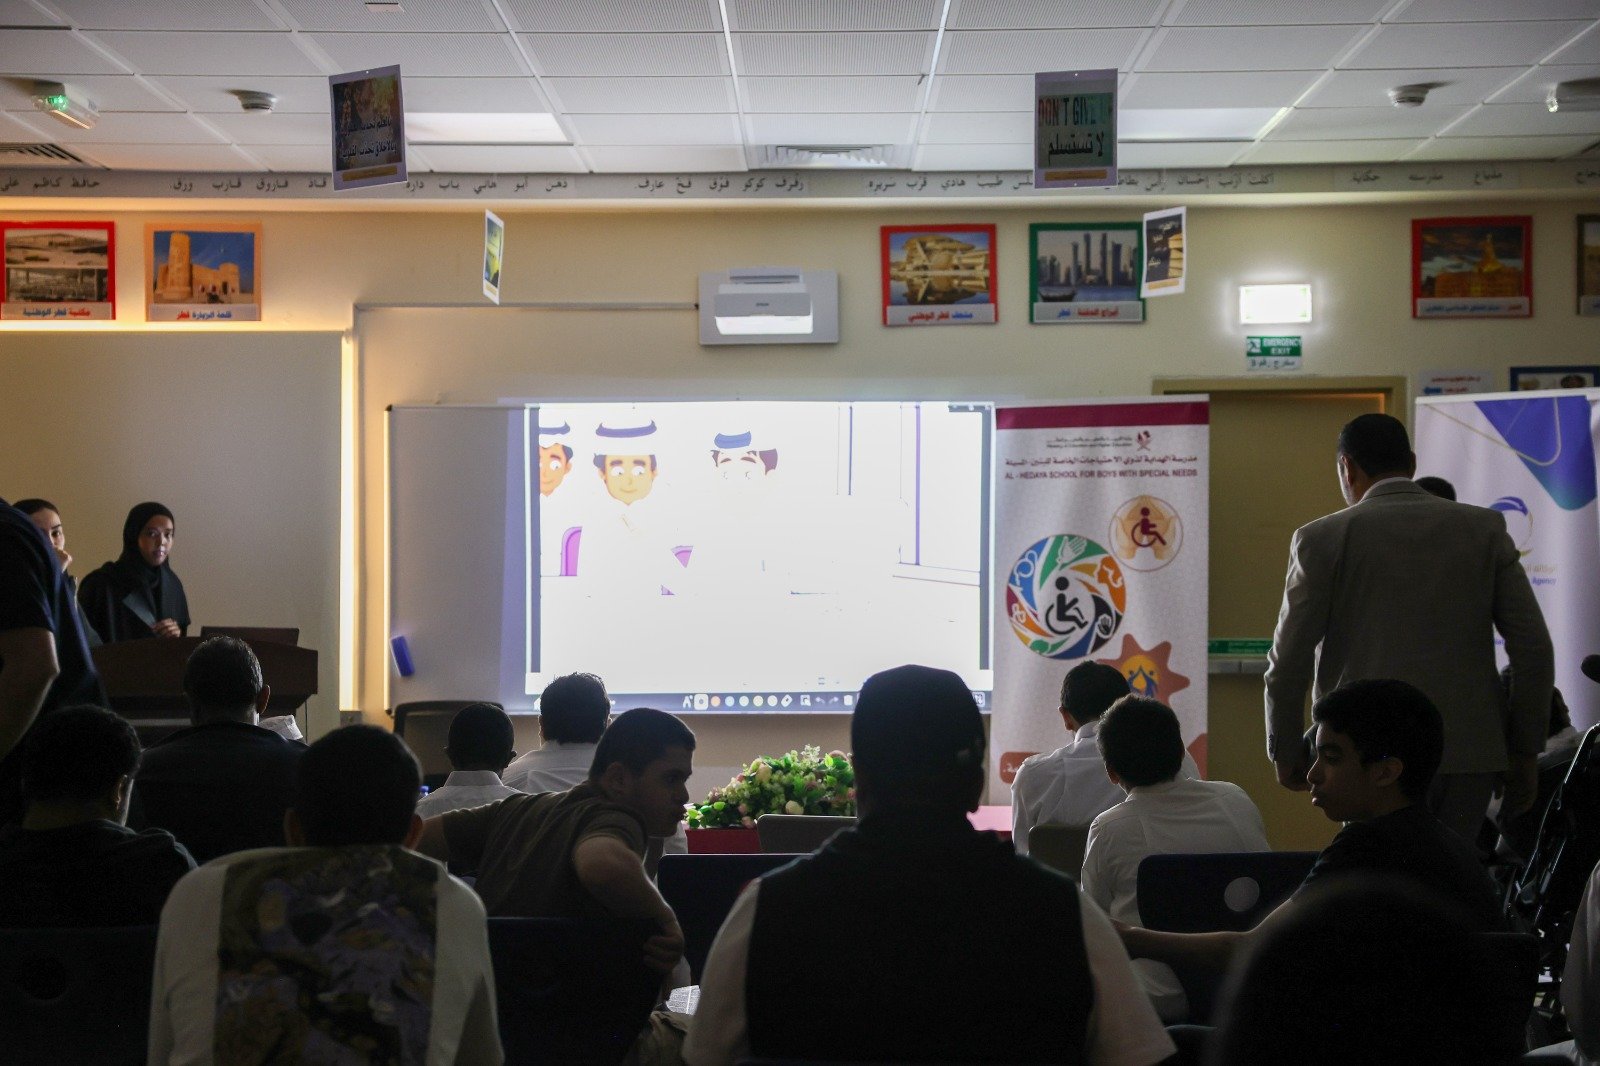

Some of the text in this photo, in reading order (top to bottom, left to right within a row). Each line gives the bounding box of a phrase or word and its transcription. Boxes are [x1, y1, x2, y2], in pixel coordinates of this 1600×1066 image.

[1270, 347, 1291, 356] EXIT
[1049, 470, 1078, 479] SCHOOL
[1080, 470, 1096, 479] FOR
[1097, 470, 1117, 478] BOYS
[1119, 469, 1138, 478] WITH
[1139, 469, 1169, 478] SPECIAL
[1172, 468, 1198, 477] NEEDS
